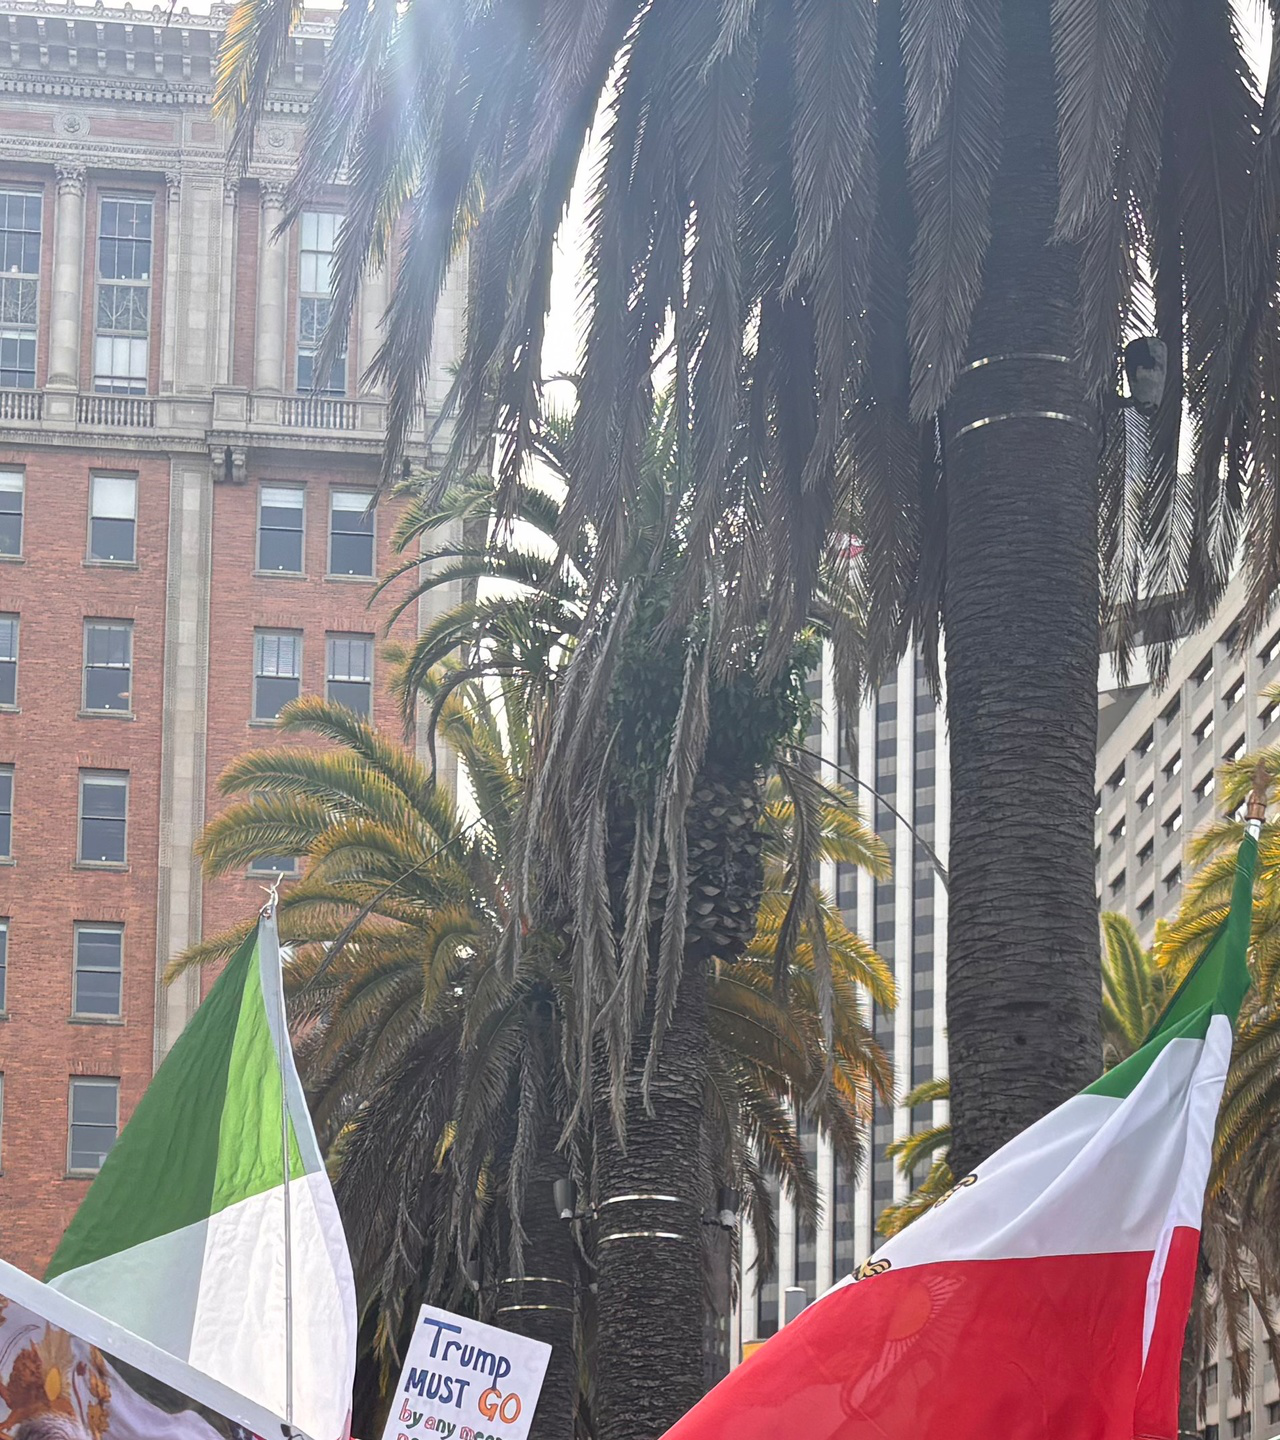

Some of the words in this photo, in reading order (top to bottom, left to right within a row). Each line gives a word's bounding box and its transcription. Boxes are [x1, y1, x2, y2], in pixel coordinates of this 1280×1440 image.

[424, 1317, 511, 1390] Trump
[399, 1398, 423, 1429] by
[424, 1417, 455, 1440] any
[404, 1367, 470, 1408] MUST
[478, 1388, 522, 1424] GO
